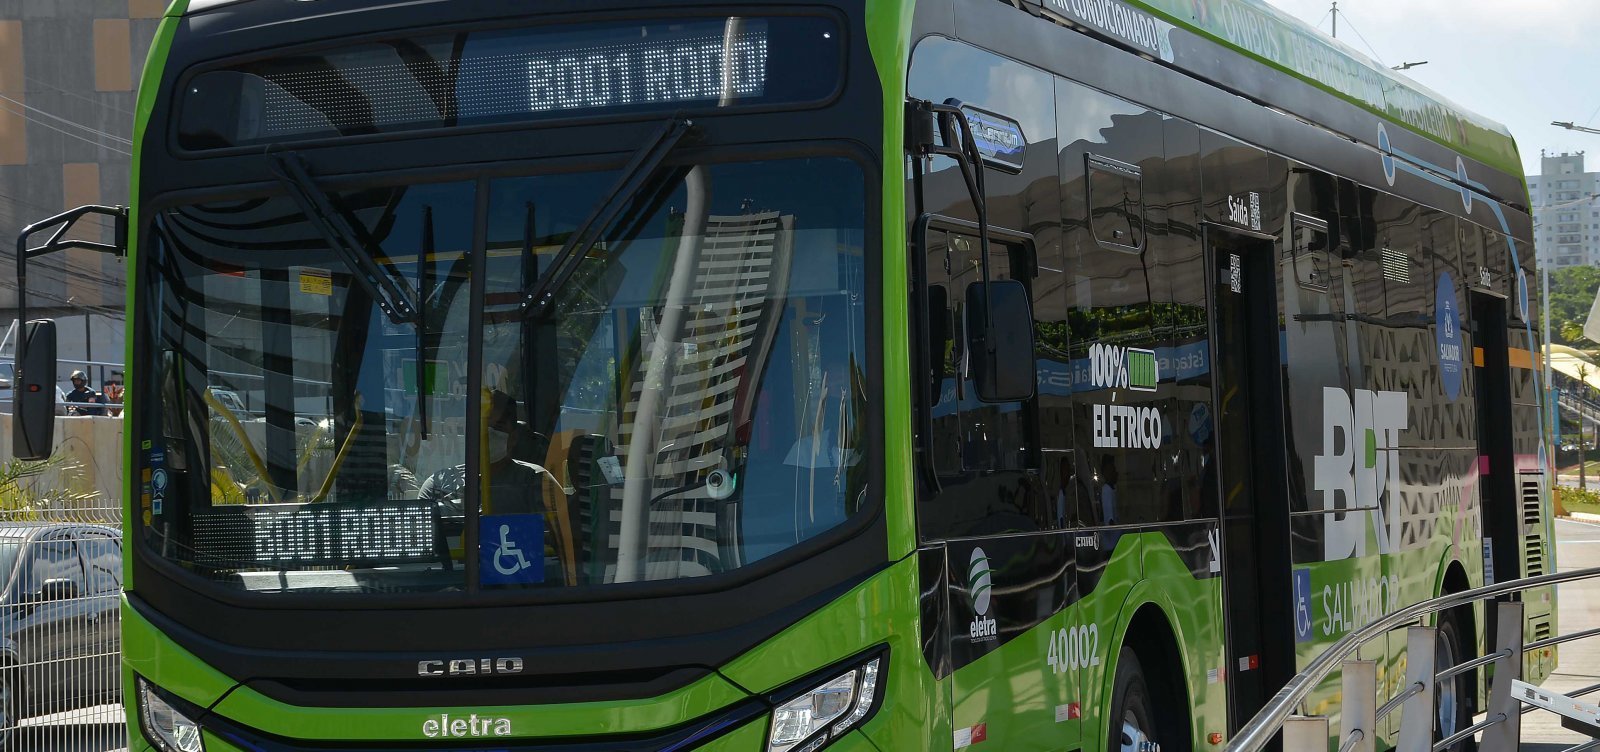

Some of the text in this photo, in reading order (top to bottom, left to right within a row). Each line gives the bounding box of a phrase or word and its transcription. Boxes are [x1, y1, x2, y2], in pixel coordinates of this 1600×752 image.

[1228, 194, 1249, 226] Saída
[1088, 343, 1128, 389] 100%
[1440, 343, 1460, 361] SALVADOR
[1093, 391, 1162, 449] ELÉTRICO
[1314, 386, 1408, 562] BRT
[1322, 574, 1399, 636] SALVADOR
[970, 615, 997, 638] eletra
[417, 657, 524, 676] CAIO
[1047, 622, 1100, 675] 40002
[422, 713, 512, 738] eletra
